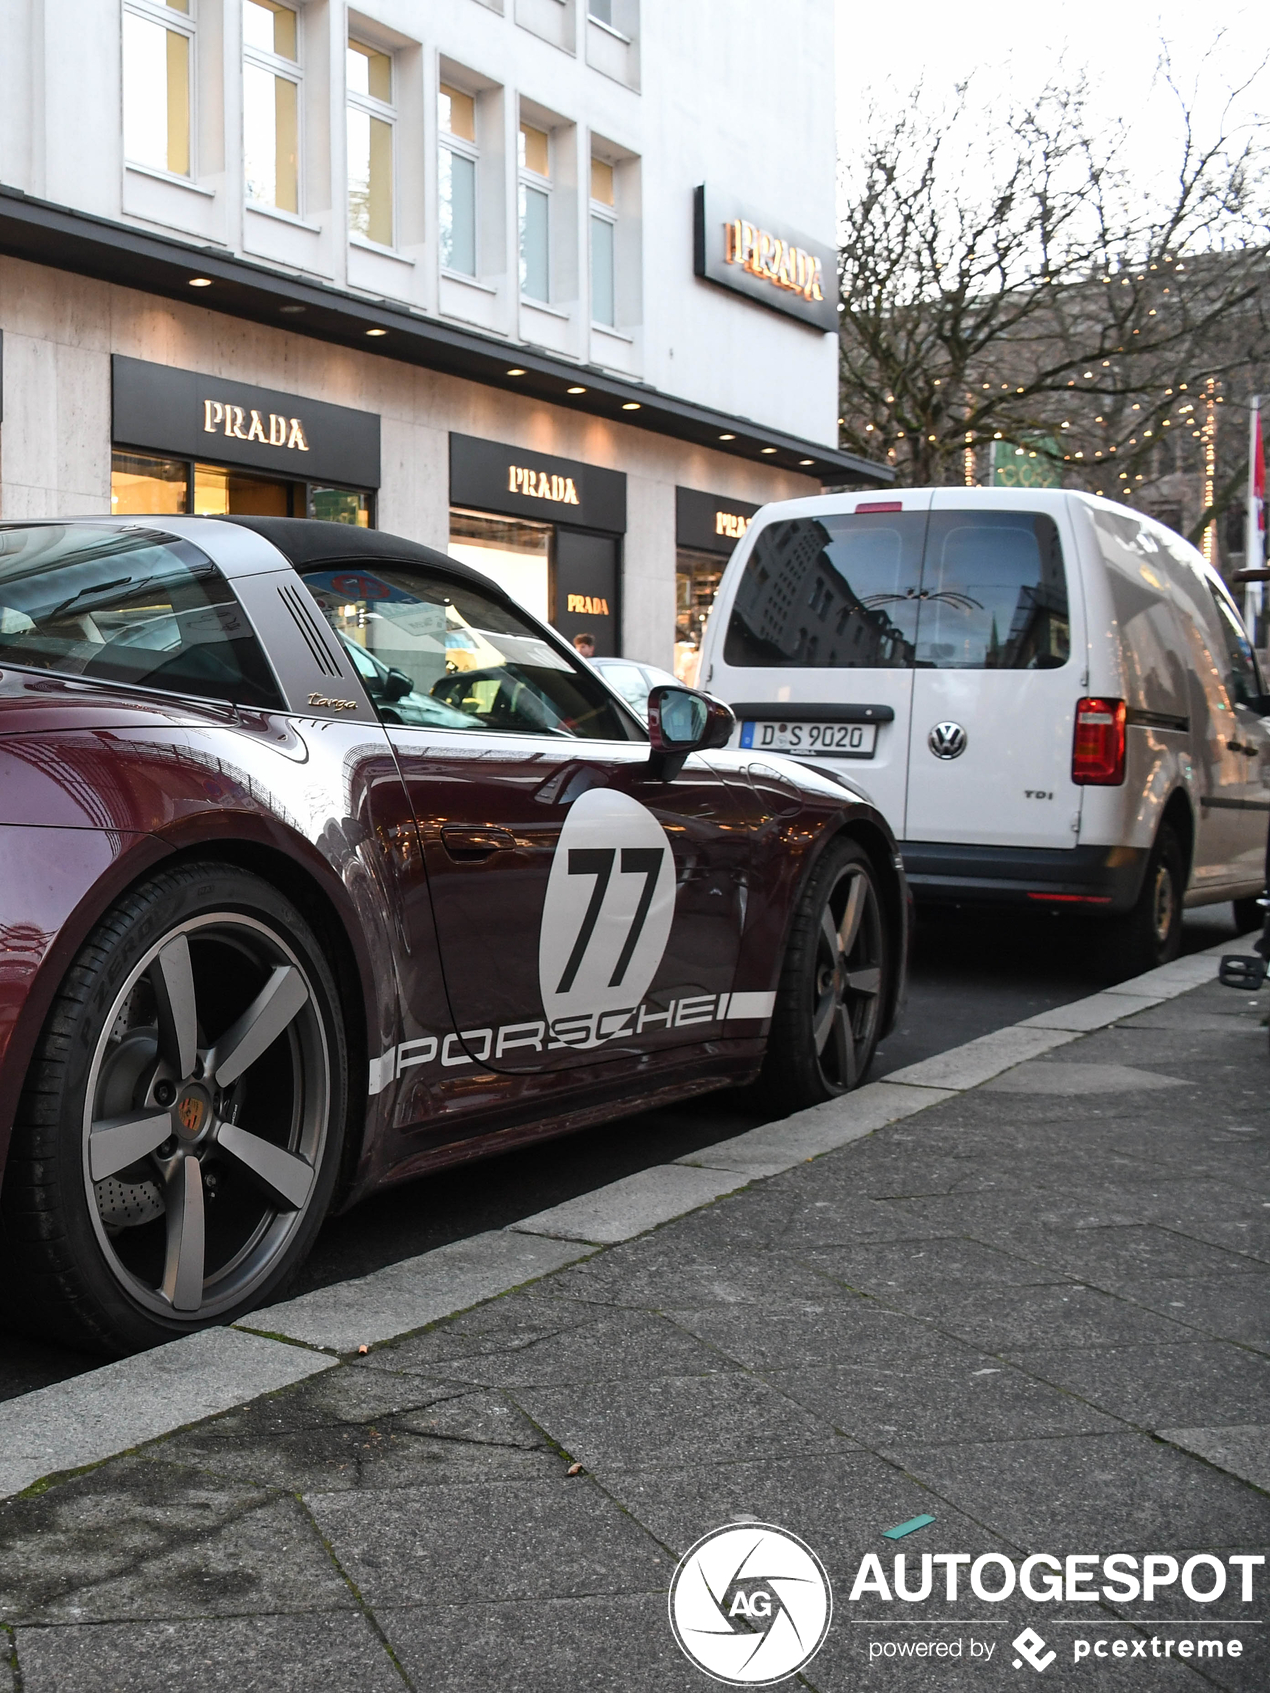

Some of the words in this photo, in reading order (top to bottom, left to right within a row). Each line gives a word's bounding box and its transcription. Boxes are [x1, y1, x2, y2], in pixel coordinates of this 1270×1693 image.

[731, 219, 826, 301] PRADA
[204, 399, 309, 451] PRADA
[508, 465, 580, 505] PRADA
[716, 511, 753, 539] PRA
[567, 594, 609, 615] PRADA
[761, 725, 775, 746] D
[789, 725, 803, 747] S
[809, 726, 863, 749] 9020
[1024, 790, 1053, 800] TDI
[555, 848, 665, 994] 77
[396, 994, 717, 1079] PORSCHE
